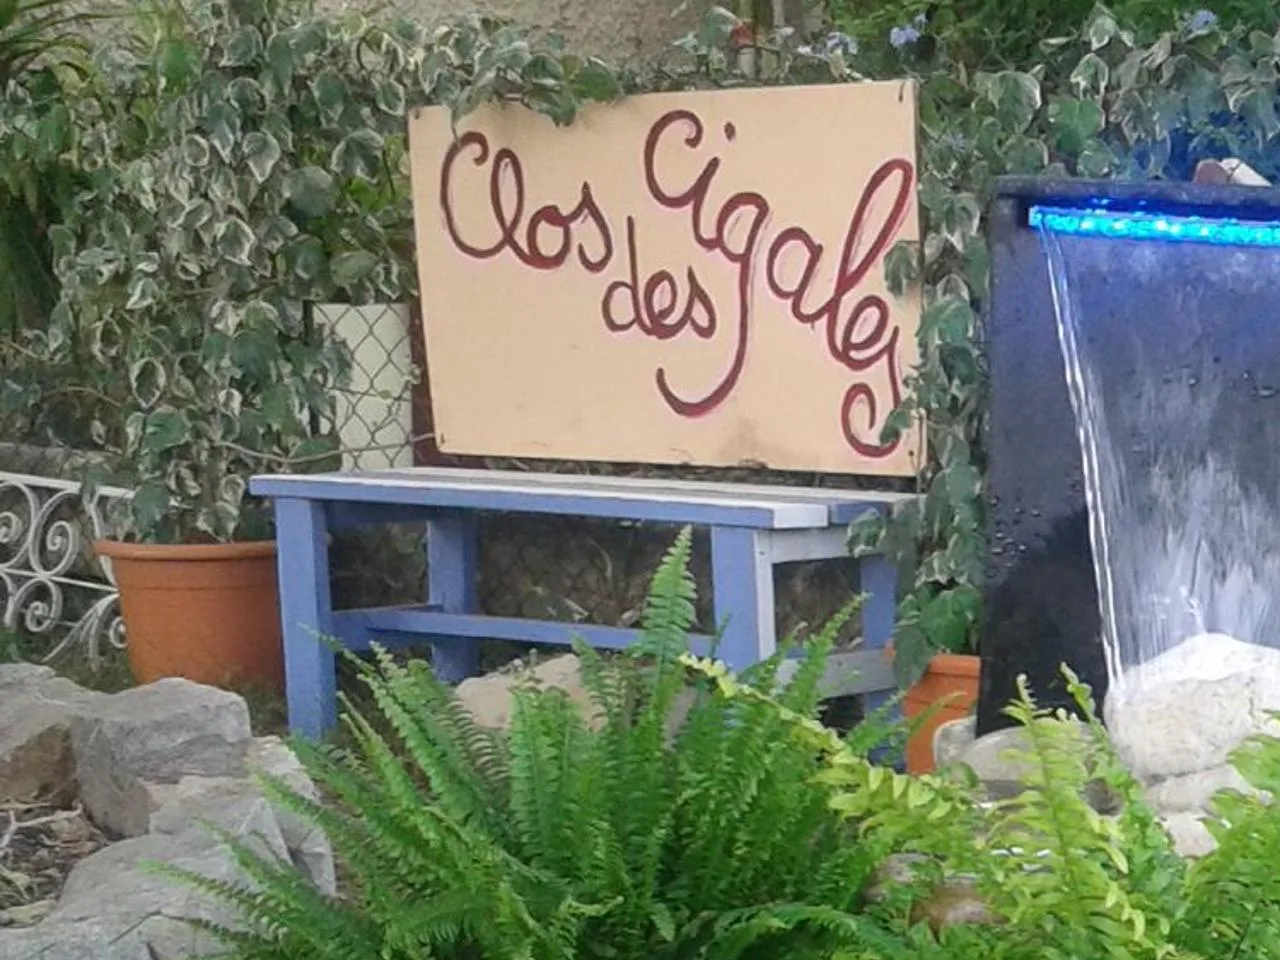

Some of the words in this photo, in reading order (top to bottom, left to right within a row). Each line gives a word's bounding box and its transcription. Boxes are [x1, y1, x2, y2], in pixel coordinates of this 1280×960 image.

[440, 130, 613, 272] Clos
[602, 215, 717, 338] des
[643, 109, 913, 458] Cigales
